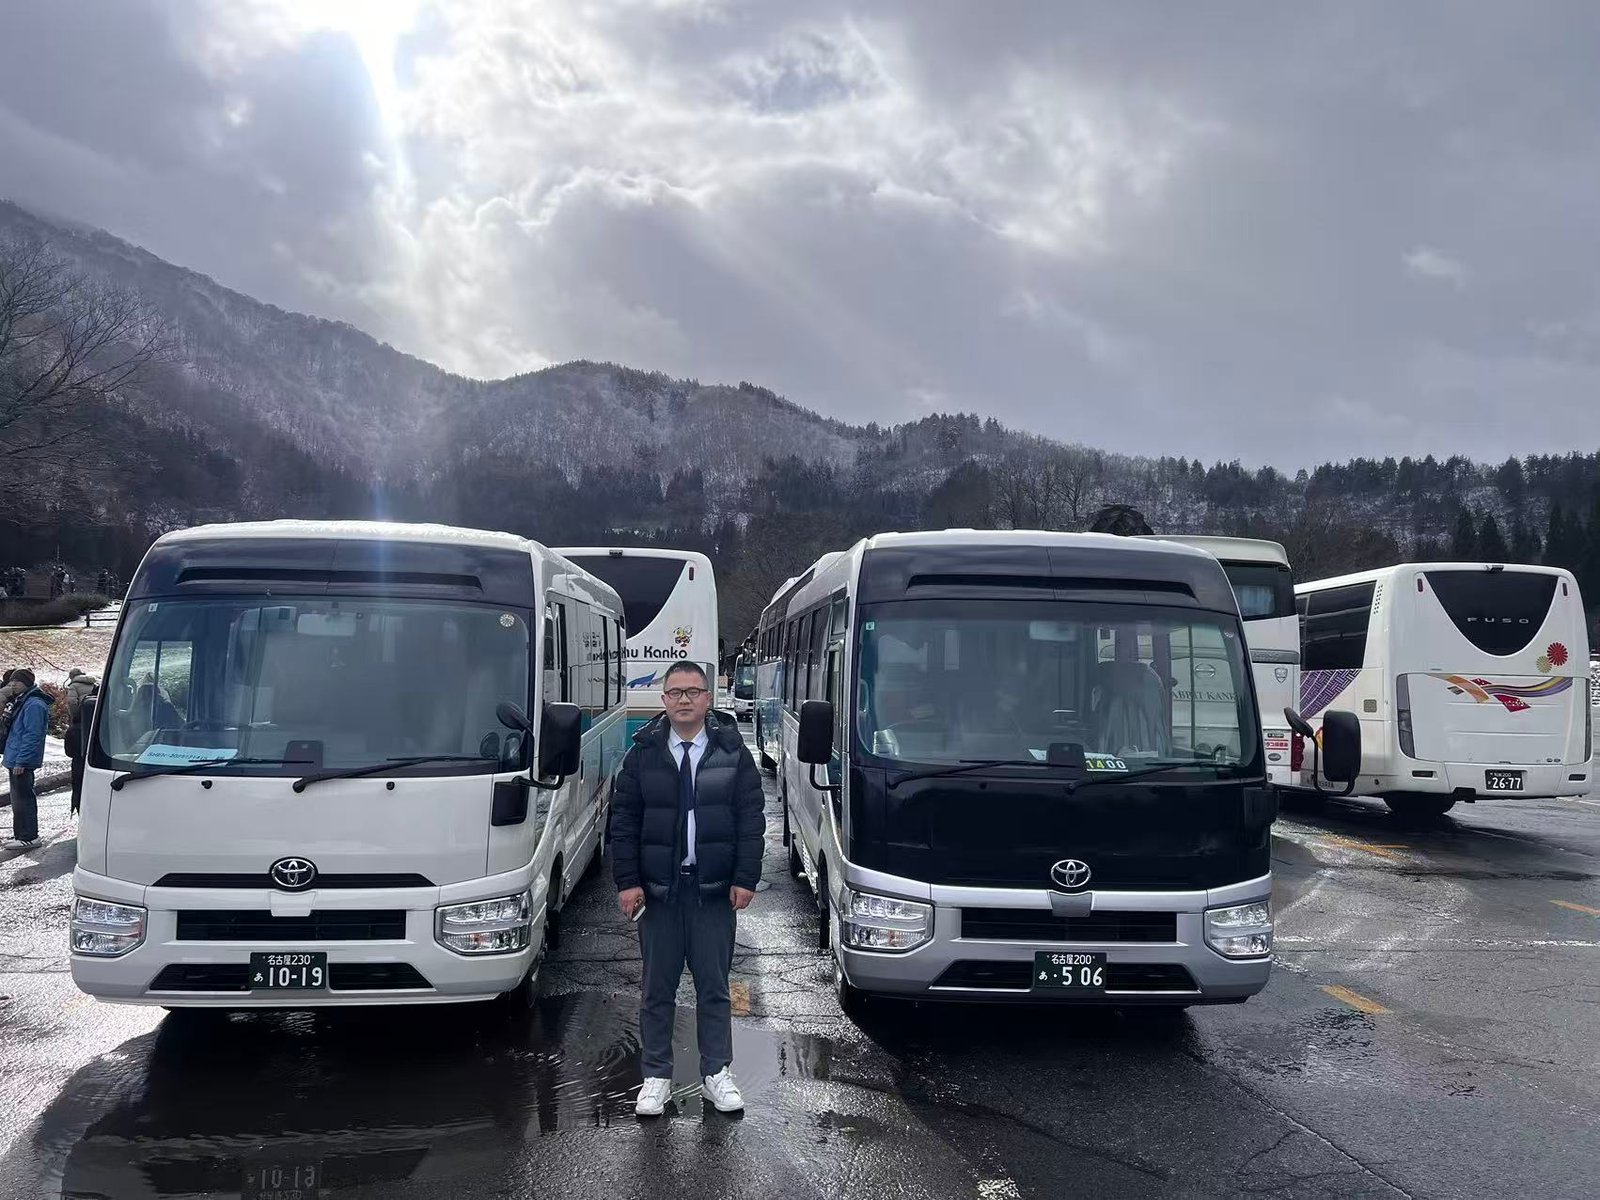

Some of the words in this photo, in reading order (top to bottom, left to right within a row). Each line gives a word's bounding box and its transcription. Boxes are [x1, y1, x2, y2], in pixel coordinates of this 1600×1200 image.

[643, 645, 688, 659] Kanko
[1492, 777, 1521, 789] 26-77
[267, 954, 311, 966] 名古屋230
[1051, 953, 1092, 965] 名古屋200
[253, 972, 264, 983] あ
[268, 967, 323, 987] 10-19
[1038, 970, 1048, 981] あ
